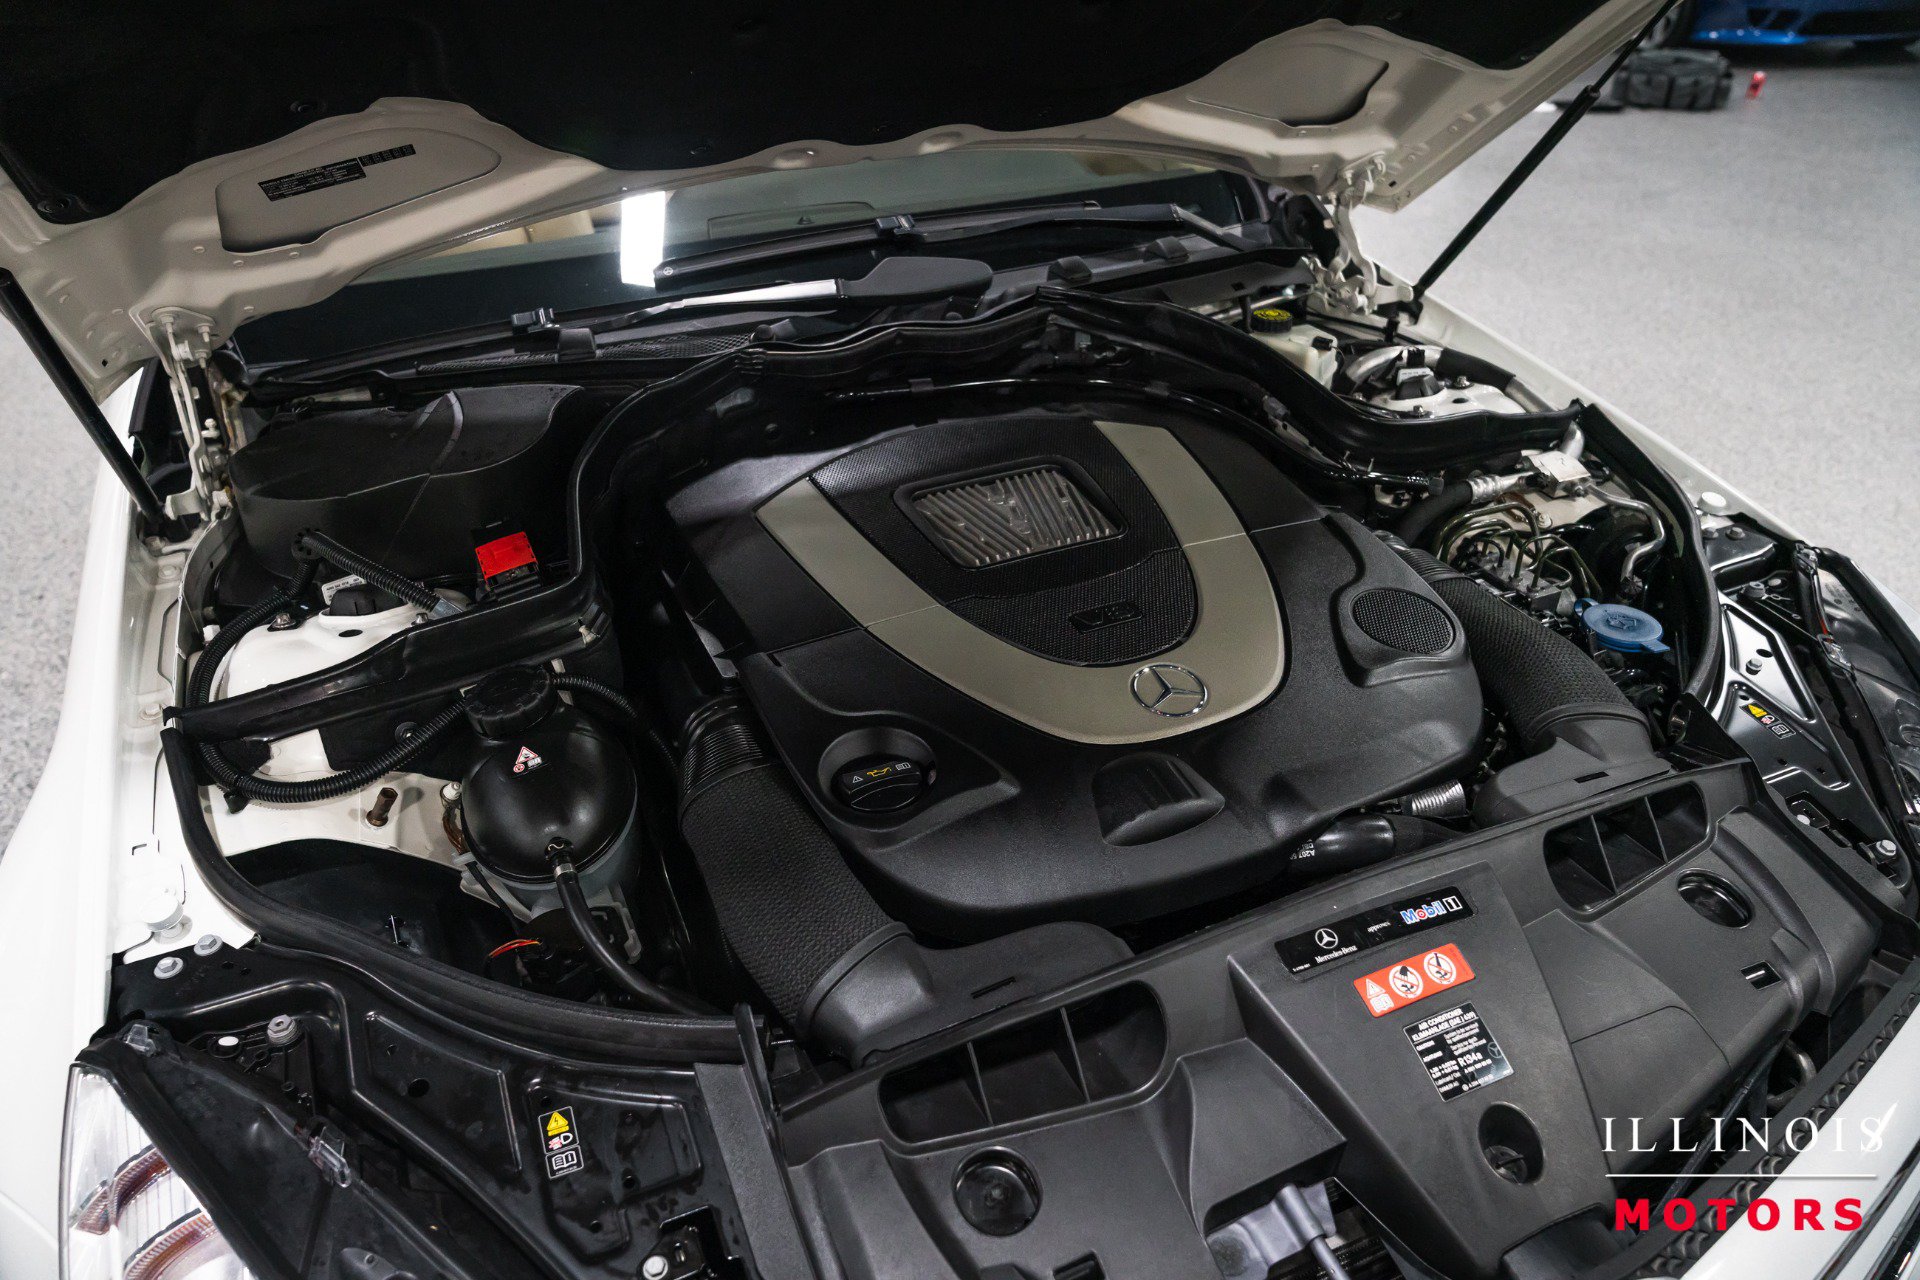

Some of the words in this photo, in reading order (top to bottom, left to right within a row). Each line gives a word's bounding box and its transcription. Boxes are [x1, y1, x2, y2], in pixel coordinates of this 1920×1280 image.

[1400, 900, 1447, 925] Mobil
[1314, 945, 1358, 964] Mercedes-Benz
[1418, 1021, 1428, 1031] AIR
[1427, 1008, 1463, 1026] CONDITIONER
[1457, 1052, 1484, 1067] R134a
